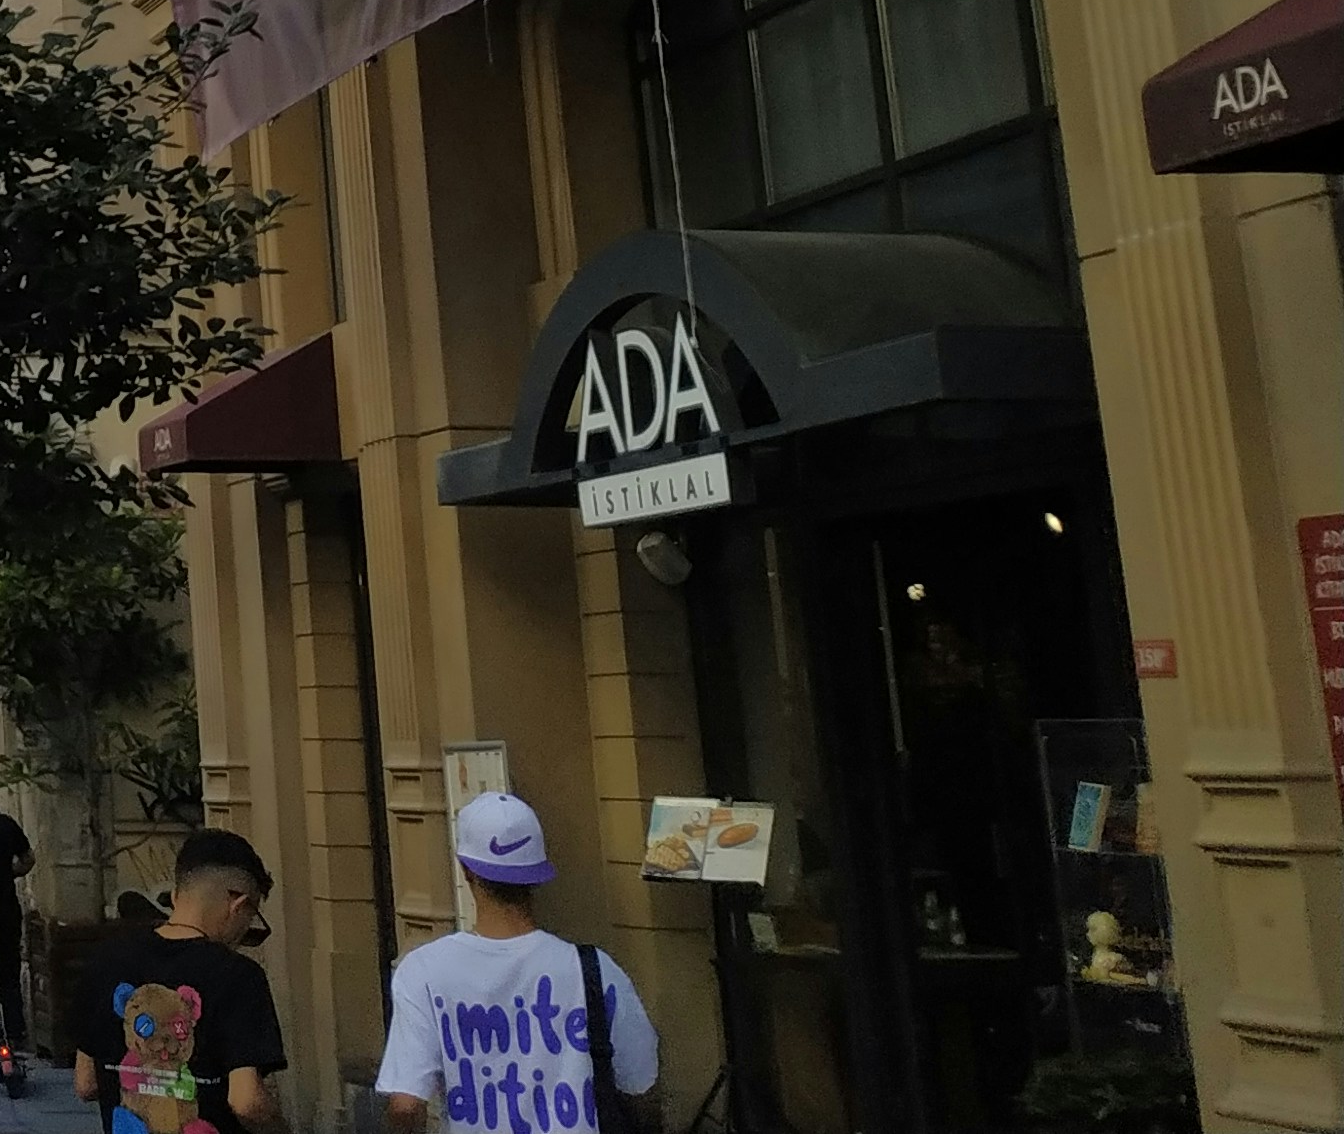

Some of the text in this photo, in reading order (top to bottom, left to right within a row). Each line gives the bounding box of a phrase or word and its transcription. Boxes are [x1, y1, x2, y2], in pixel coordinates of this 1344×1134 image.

[1212, 58, 1288, 120] ADA
[576, 311, 721, 464] ADA
[591, 471, 716, 518] İSTİKLAL
